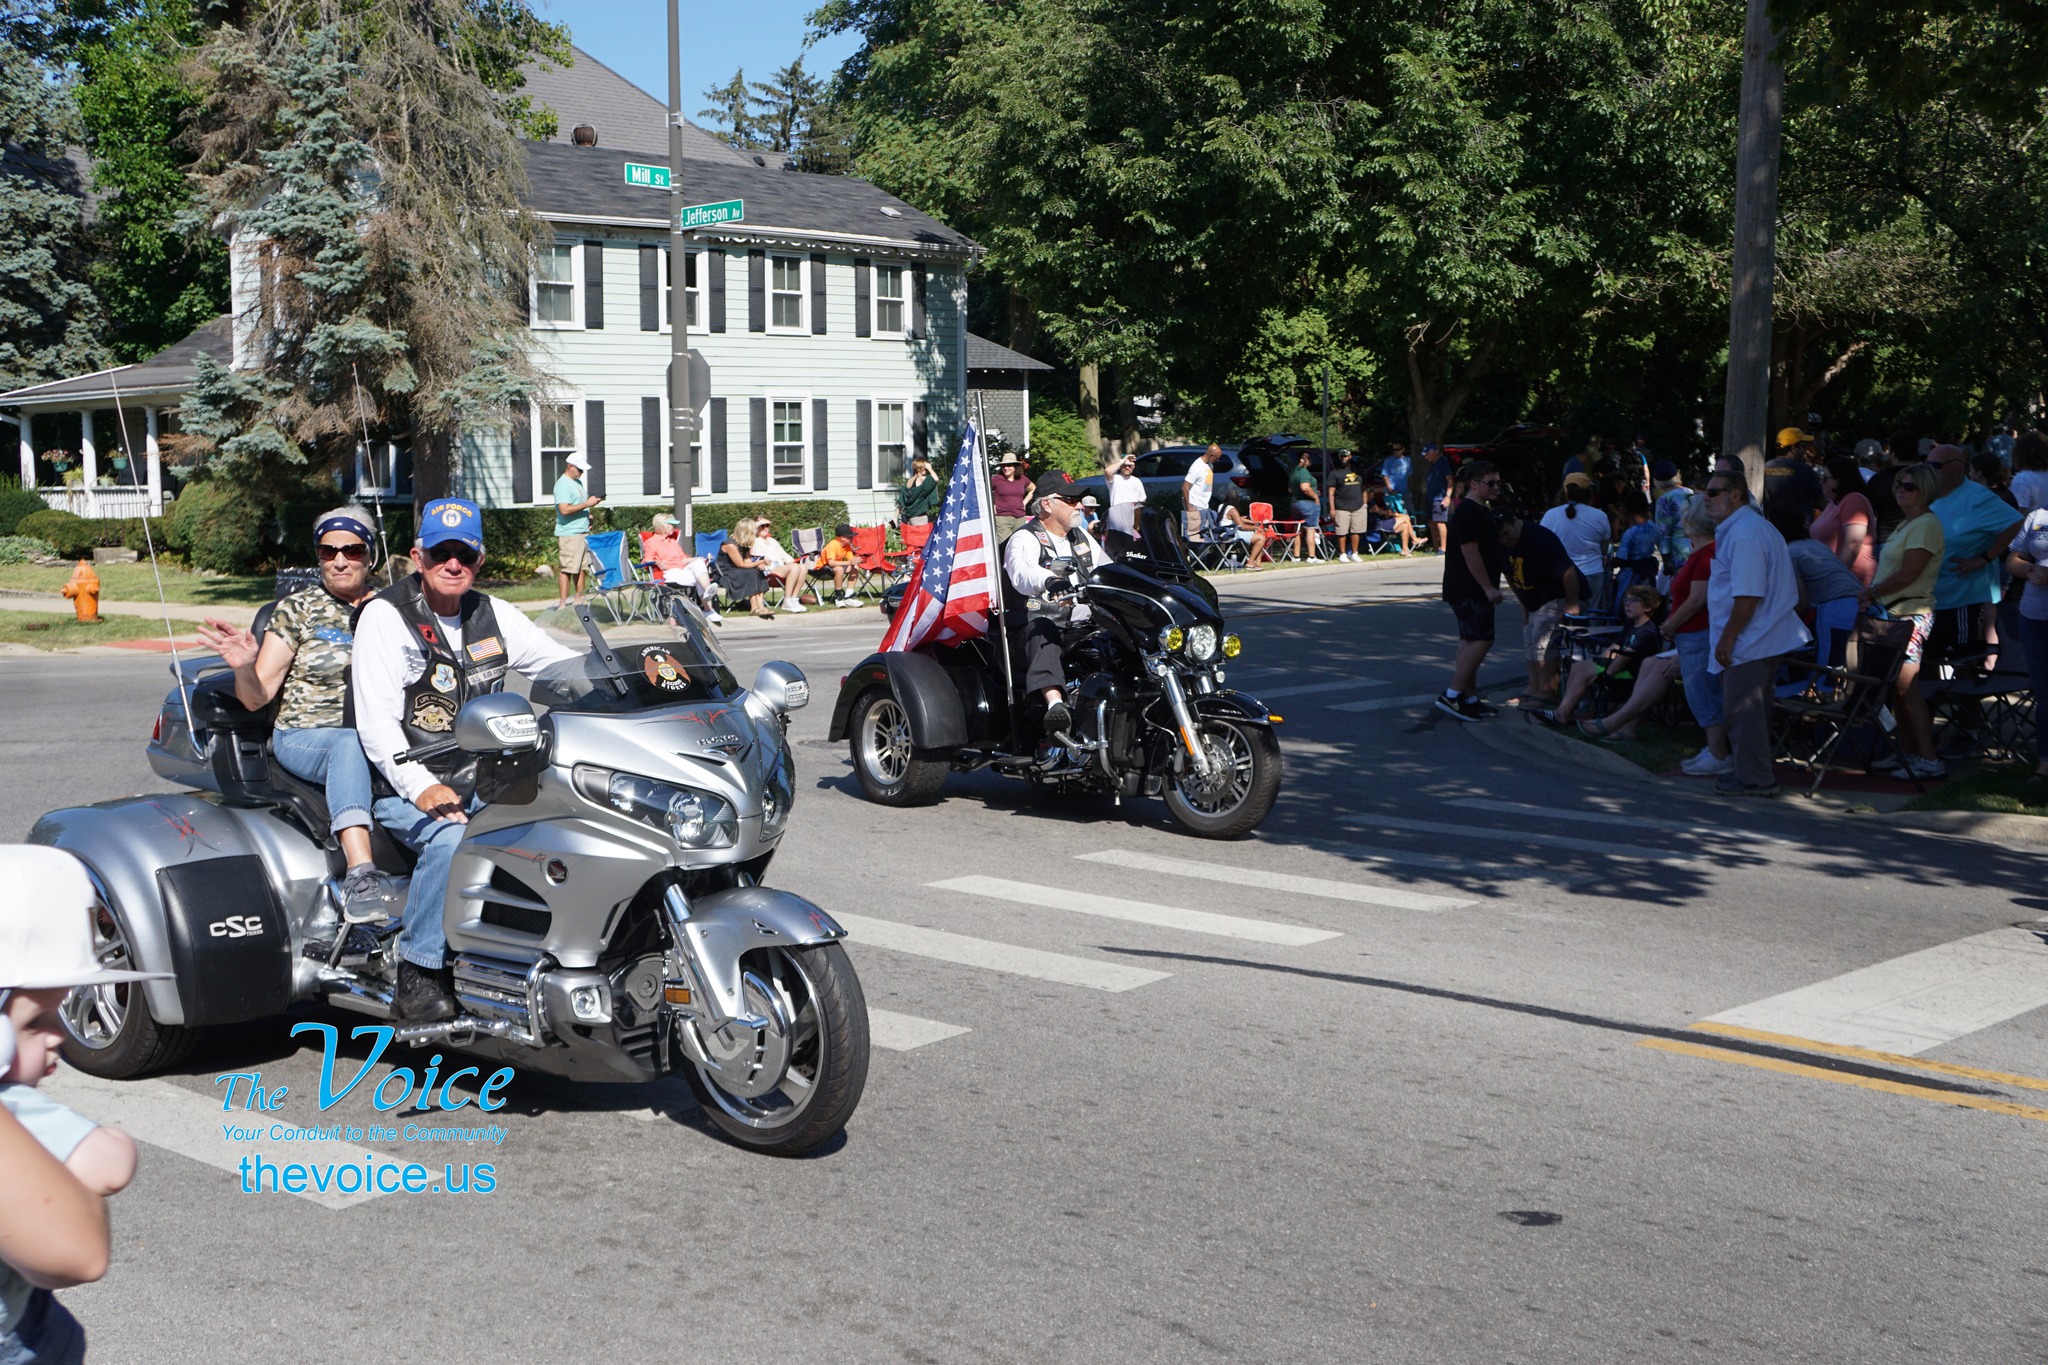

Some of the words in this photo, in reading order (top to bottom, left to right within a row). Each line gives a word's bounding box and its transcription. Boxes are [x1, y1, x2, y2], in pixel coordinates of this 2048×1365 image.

[631, 166, 651, 184] Mill
[654, 174, 664, 186] St
[685, 207, 728, 225] Jefferson
[731, 208, 741, 219] Av
[431, 504, 445, 516] AIR
[445, 503, 473, 518] FORCE
[1125, 551, 1148, 560] Shaker
[640, 645, 671, 658] AMERICAN
[418, 695, 431, 704] LIFE
